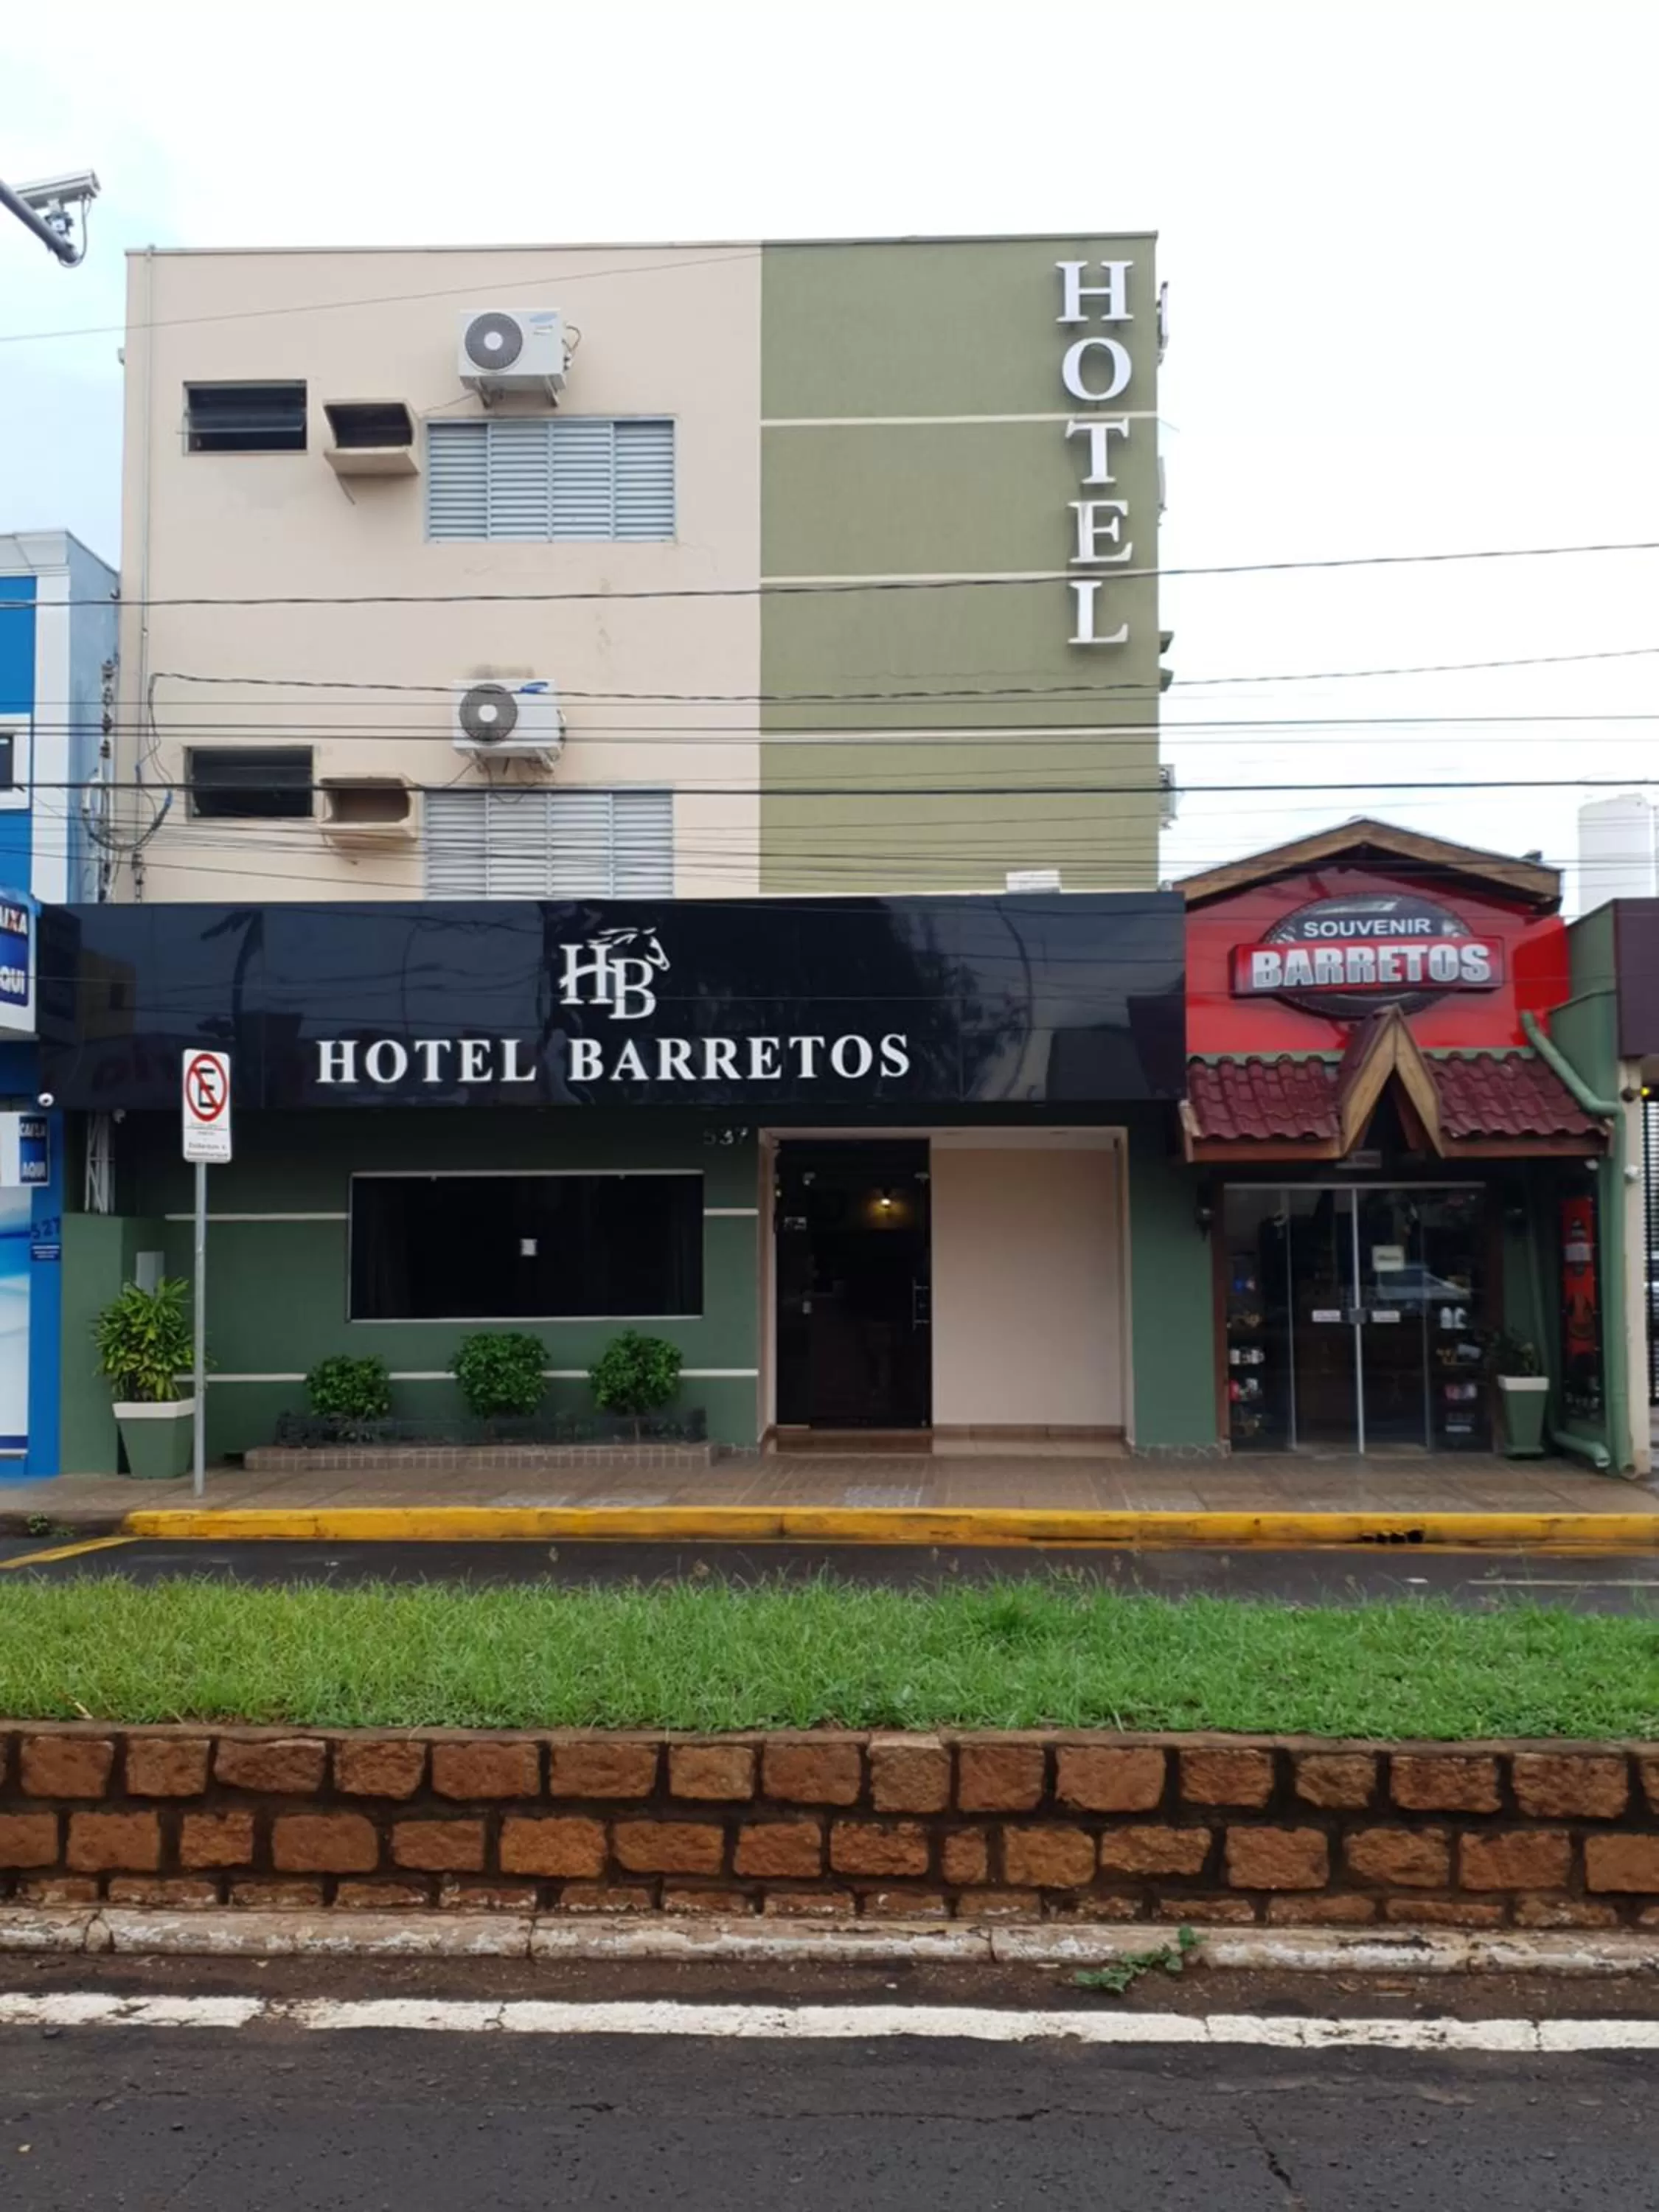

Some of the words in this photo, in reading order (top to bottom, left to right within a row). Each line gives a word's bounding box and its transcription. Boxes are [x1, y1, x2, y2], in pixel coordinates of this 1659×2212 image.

[1055, 260, 1134, 644] HOTEL
[1303, 918, 1431, 938] SOUVENIR
[1251, 943, 1492, 989] BARRETOS
[316, 1038, 537, 1084] HOTEL
[568, 1033, 911, 1082] BARRETOS
